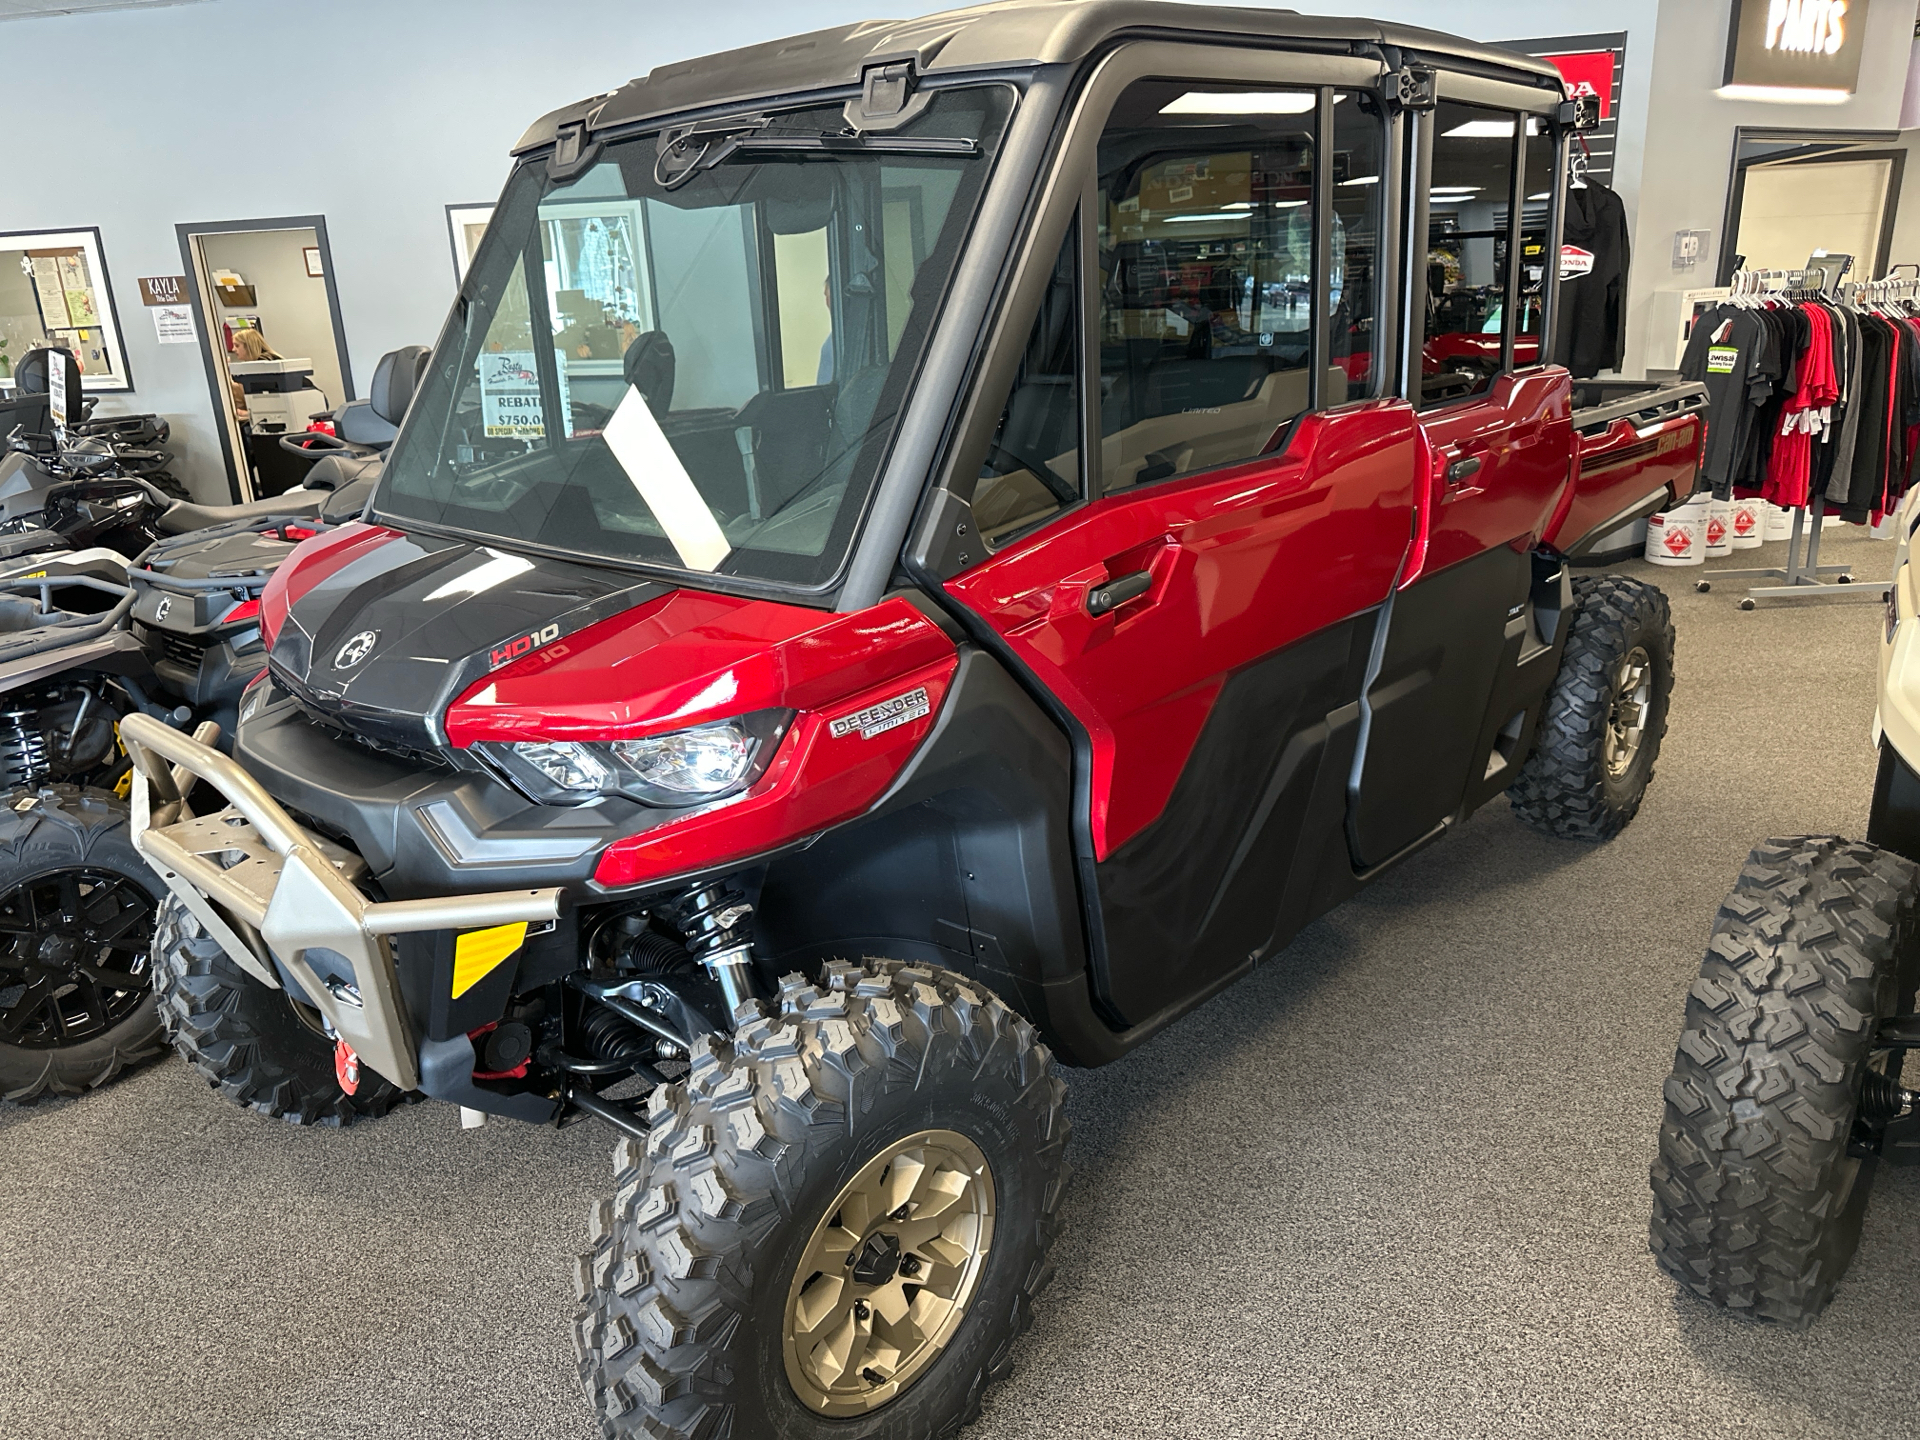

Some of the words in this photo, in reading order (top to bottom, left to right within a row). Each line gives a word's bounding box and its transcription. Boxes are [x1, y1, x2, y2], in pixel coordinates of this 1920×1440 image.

[1765, 0, 1848, 55] PARTS
[147, 277, 180, 295] KAYLA
[491, 623, 559, 666] HD10
[834, 690, 927, 734] DEFENDER
